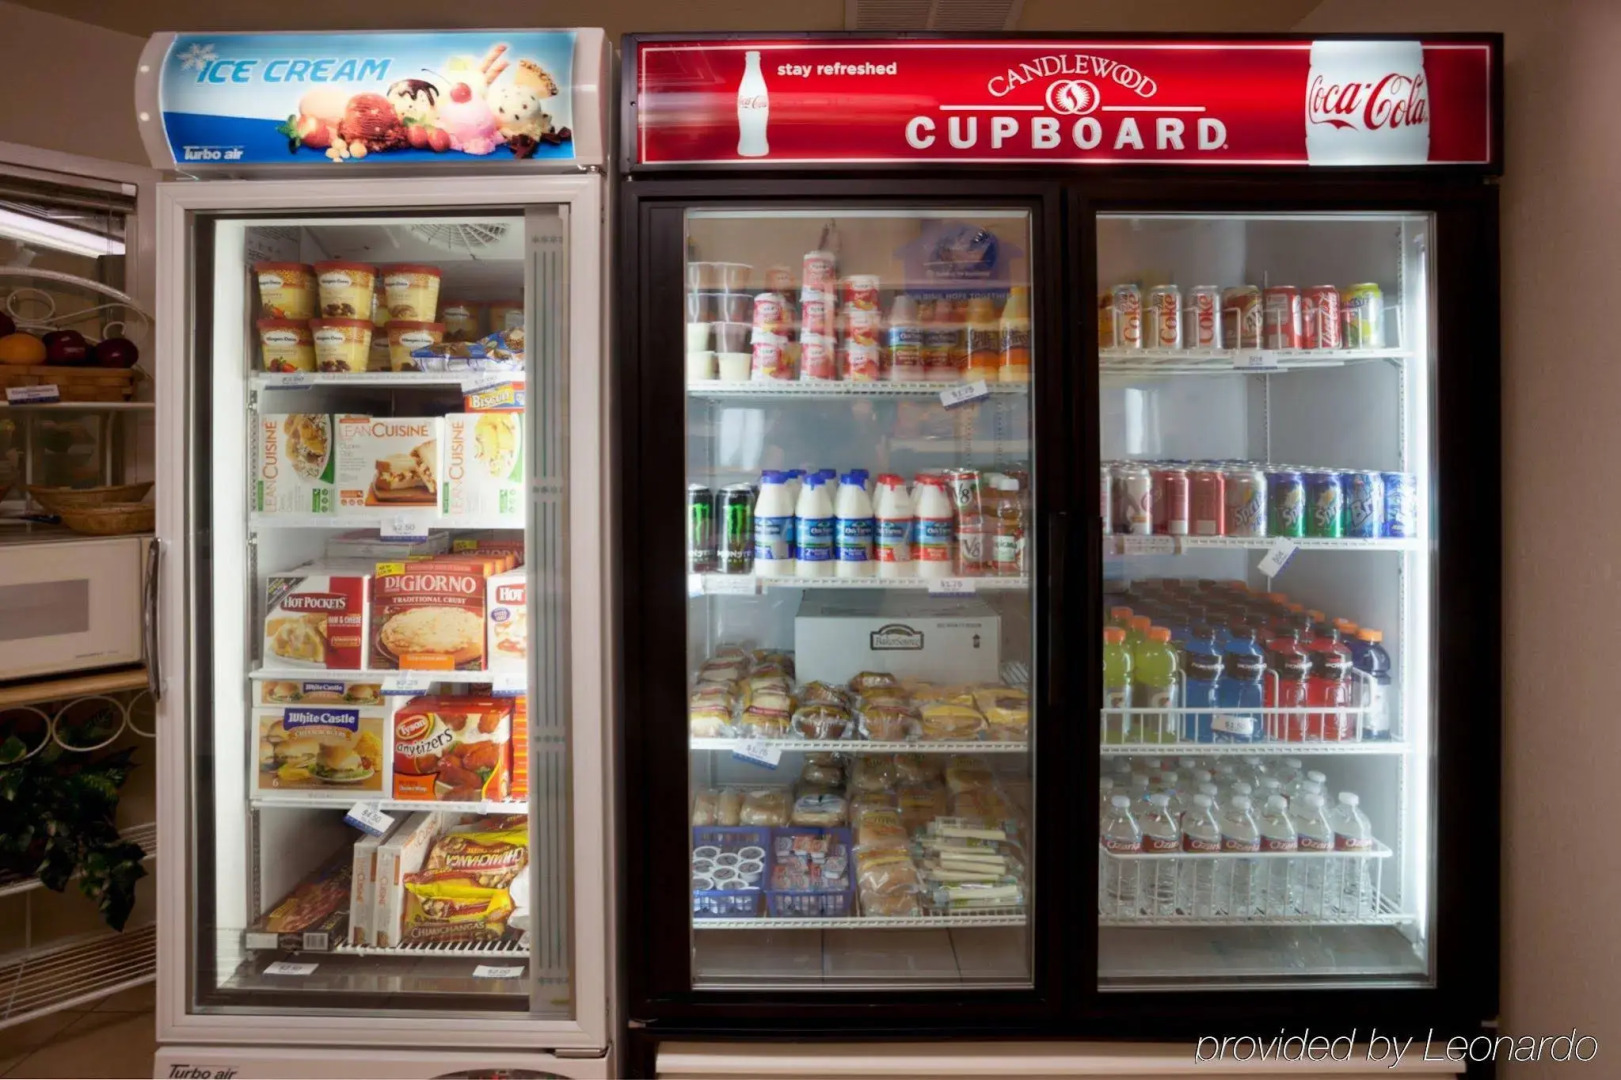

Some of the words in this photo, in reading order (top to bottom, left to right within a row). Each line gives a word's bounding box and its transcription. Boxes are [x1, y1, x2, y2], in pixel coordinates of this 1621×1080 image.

[197, 58, 250, 83] ICE
[269, 58, 393, 83] CREAM
[777, 62, 813, 78] stay
[817, 61, 897, 76] refreshed
[987, 54, 1159, 98] CANDLEWOOD
[905, 116, 1228, 150] CUPBOARD
[183, 146, 221, 160] Turbo
[223, 149, 244, 161] air
[1160, 293, 1178, 343] Coke
[339, 424, 371, 438] LEAN
[371, 422, 429, 438] CUISINE
[263, 421, 278, 478] CUISINE
[449, 421, 465, 480] CUISINE
[384, 573, 477, 594] DIGIORNO
[392, 596, 442, 604] TRADITIONAL
[442, 596, 467, 604] CRUST
[499, 586, 523, 601] HOT
[284, 596, 303, 609] HOT
[303, 596, 347, 609] POCKETS
[305, 683, 323, 692] White
[323, 683, 343, 692] Castle
[287, 710, 320, 724] White
[320, 711, 355, 724] Castle
[400, 718, 426, 736] Tyson
[272, 778, 279, 788] 6
[169, 1064, 211, 1080] Turbo
[214, 1069, 238, 1080] air
